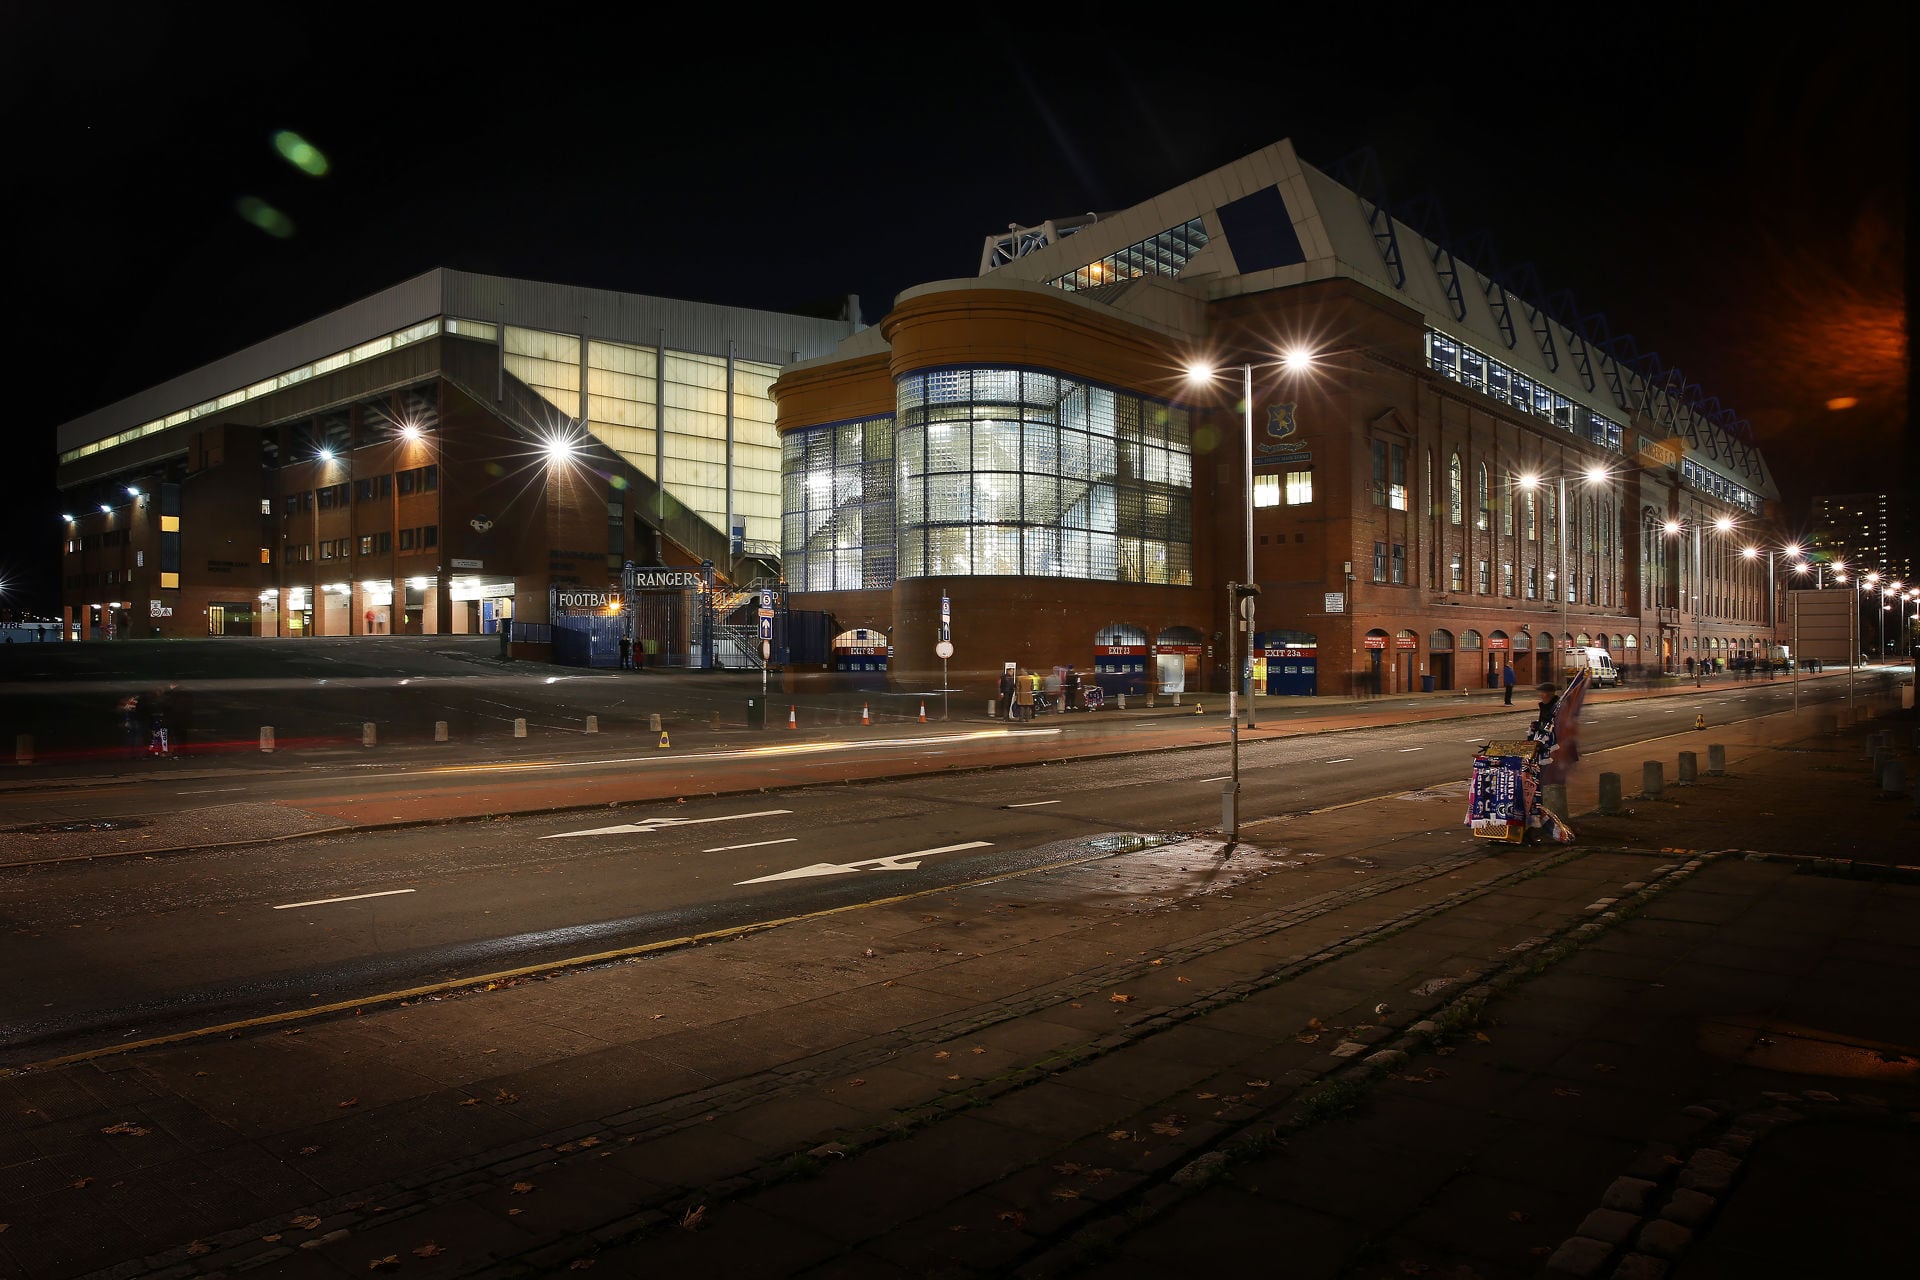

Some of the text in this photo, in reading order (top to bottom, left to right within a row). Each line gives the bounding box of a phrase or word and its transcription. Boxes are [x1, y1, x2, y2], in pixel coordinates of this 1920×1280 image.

[637, 573, 701, 587] RANGERS
[850, 647, 875, 655] EXIT 25
[1108, 646, 1130, 655] EXIT 23
[1264, 649, 1301, 657] EXIT 23a
